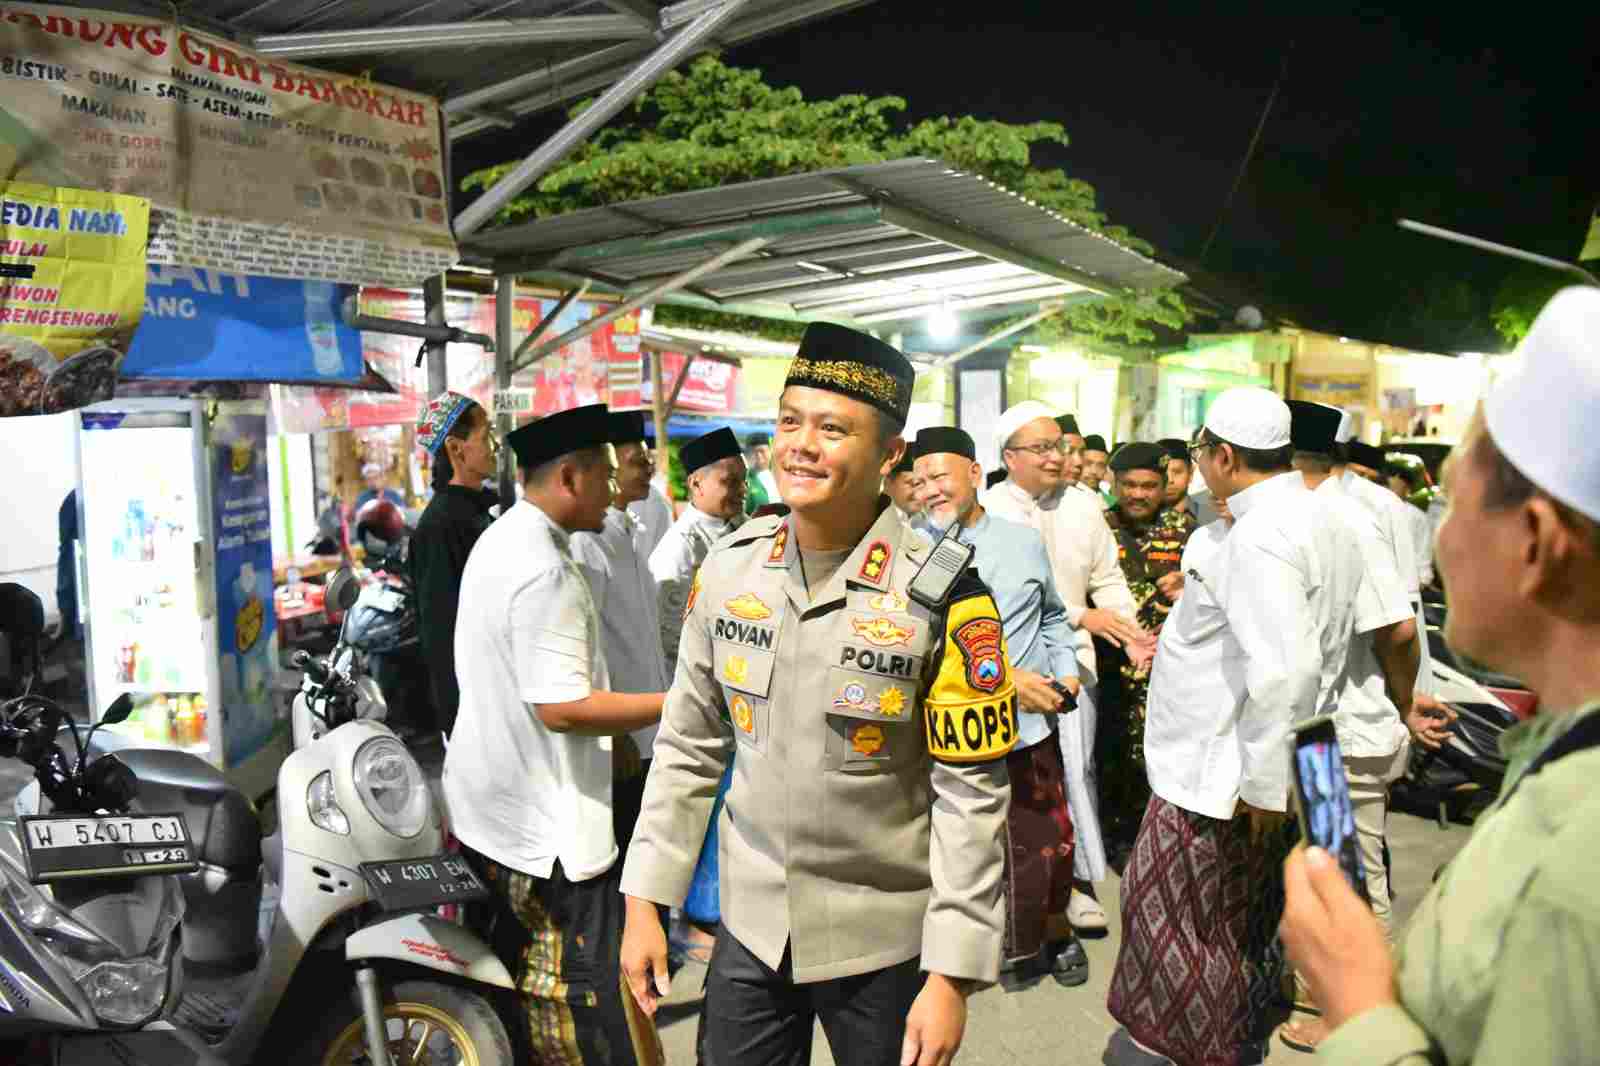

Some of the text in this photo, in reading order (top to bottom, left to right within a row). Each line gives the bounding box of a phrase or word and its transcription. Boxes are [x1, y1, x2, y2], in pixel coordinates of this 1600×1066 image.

[1, 57, 67, 81] BISTIK
[88, 70, 137, 94] GULAI
[156, 83, 190, 104] SATE
[715, 617, 774, 649] ROVAN
[840, 646, 913, 676] POLRI
[926, 707, 961, 752] KA
[35, 822, 179, 847] W 5407 CJ
[374, 867, 393, 885] W
[401, 864, 439, 880] 4307
